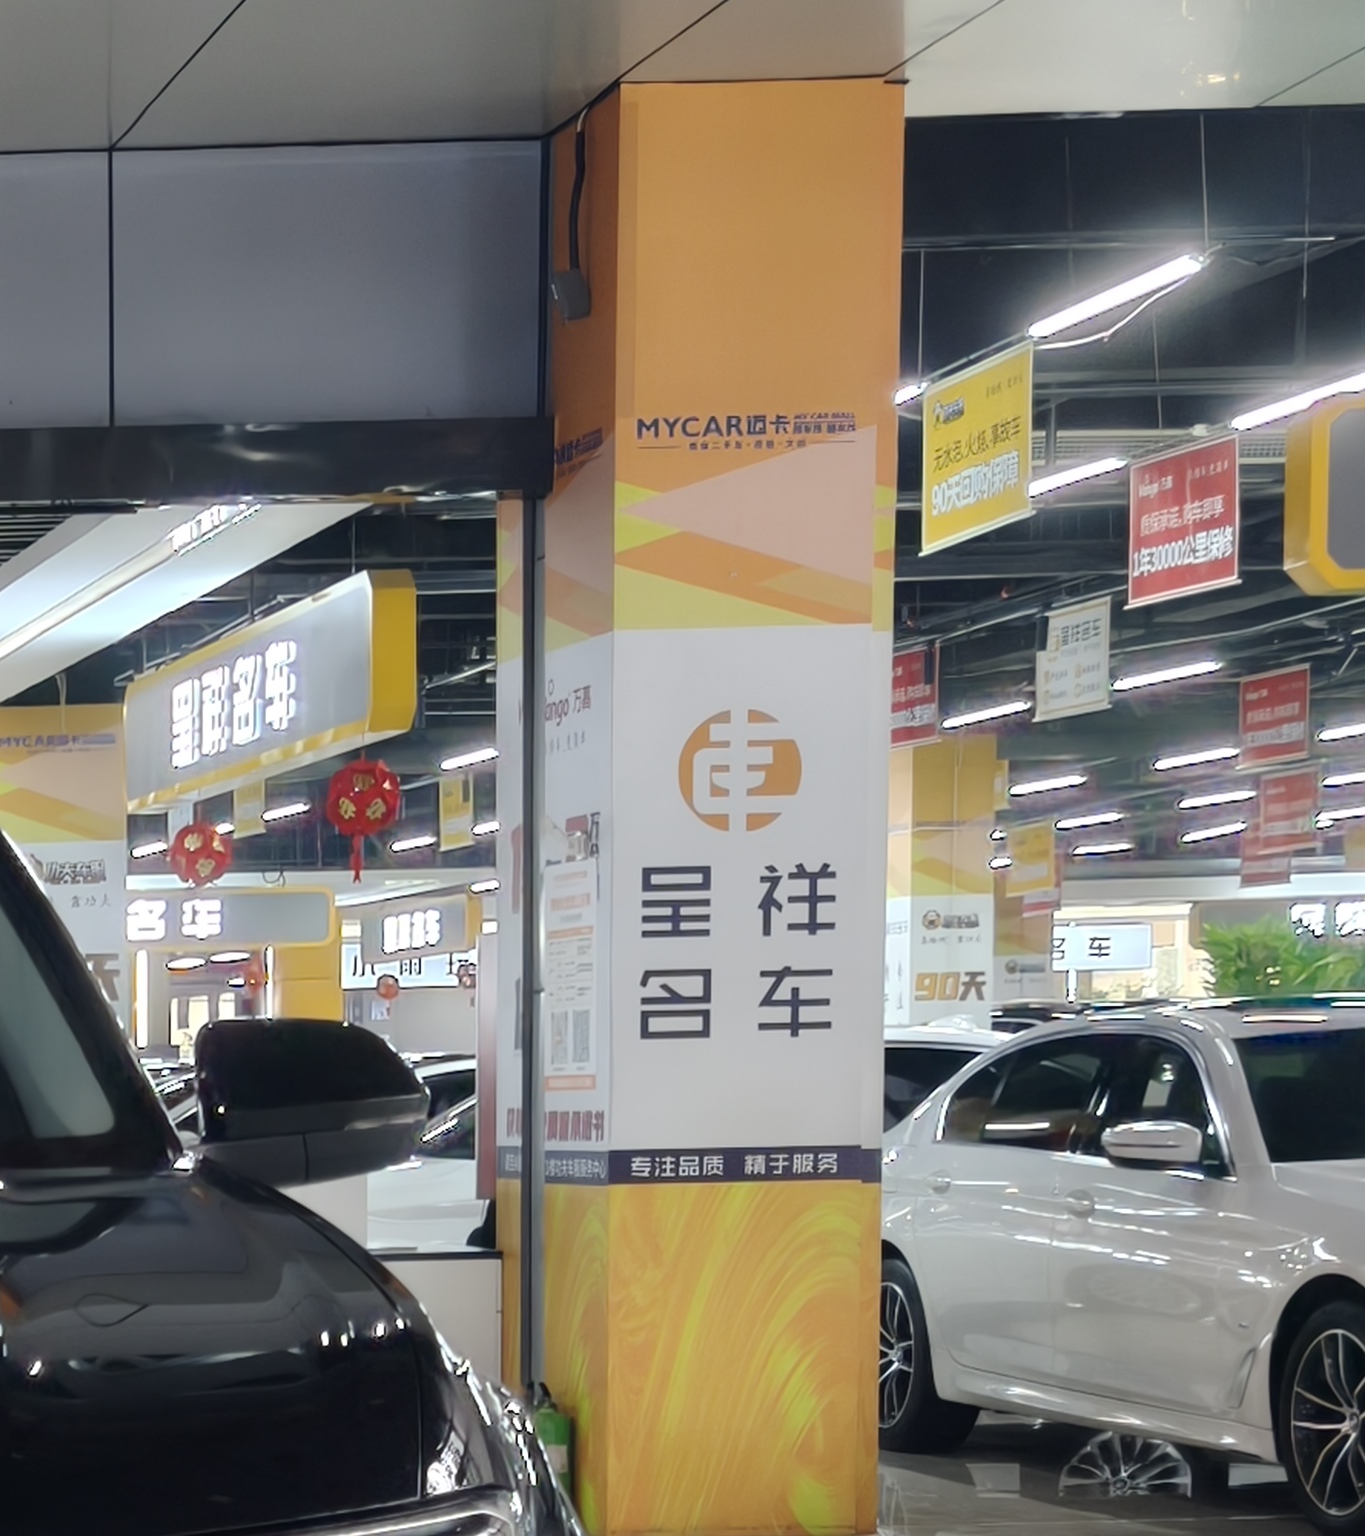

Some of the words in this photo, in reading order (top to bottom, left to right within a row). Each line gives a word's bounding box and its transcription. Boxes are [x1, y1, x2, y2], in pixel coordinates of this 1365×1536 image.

[125, 899, 223, 942] 名车
[640, 863, 837, 938] 呈祥
[639, 965, 834, 1040] 名车
[914, 971, 987, 1002] 90天
[629, 1155, 724, 1178] 专注品质
[743, 1152, 838, 1176] 精于服务
